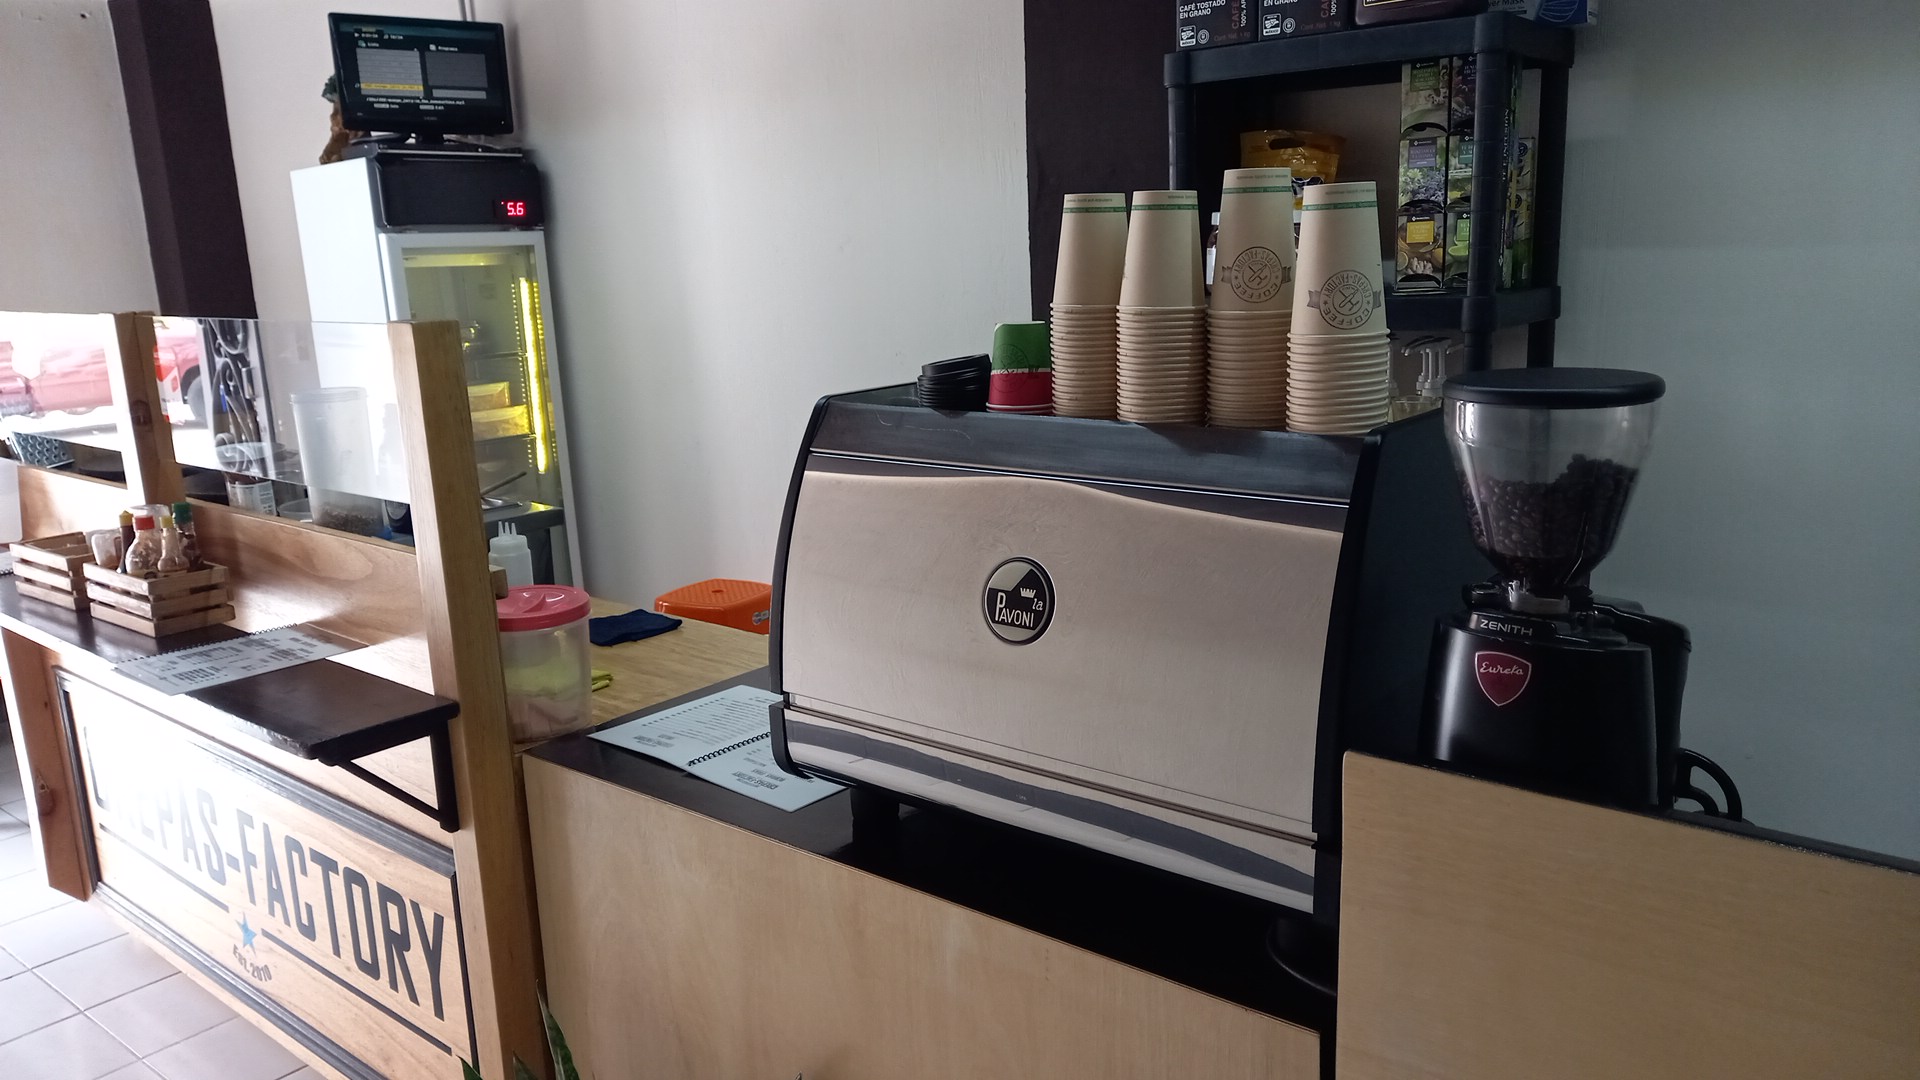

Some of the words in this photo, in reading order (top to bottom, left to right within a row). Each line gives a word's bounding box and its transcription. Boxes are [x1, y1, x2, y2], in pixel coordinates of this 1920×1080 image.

[1180, 3, 1196, 12] CAFÉ
[1197, 0, 1226, 9] TOSTADO
[1189, 8, 1211, 18] GRANO
[507, 202, 524, 216] 5.6
[1234, 282, 1278, 300] COFFEE
[1322, 306, 1370, 326] COFFEE
[995, 591, 1035, 628] PAVONI
[1032, 598, 1044, 611] la
[1479, 618, 1534, 637] ZENITH
[1479, 661, 1525, 676] Eureka
[83, 725, 445, 1022] CEPAS-FACTORY
[250, 962, 273, 982] 2010
